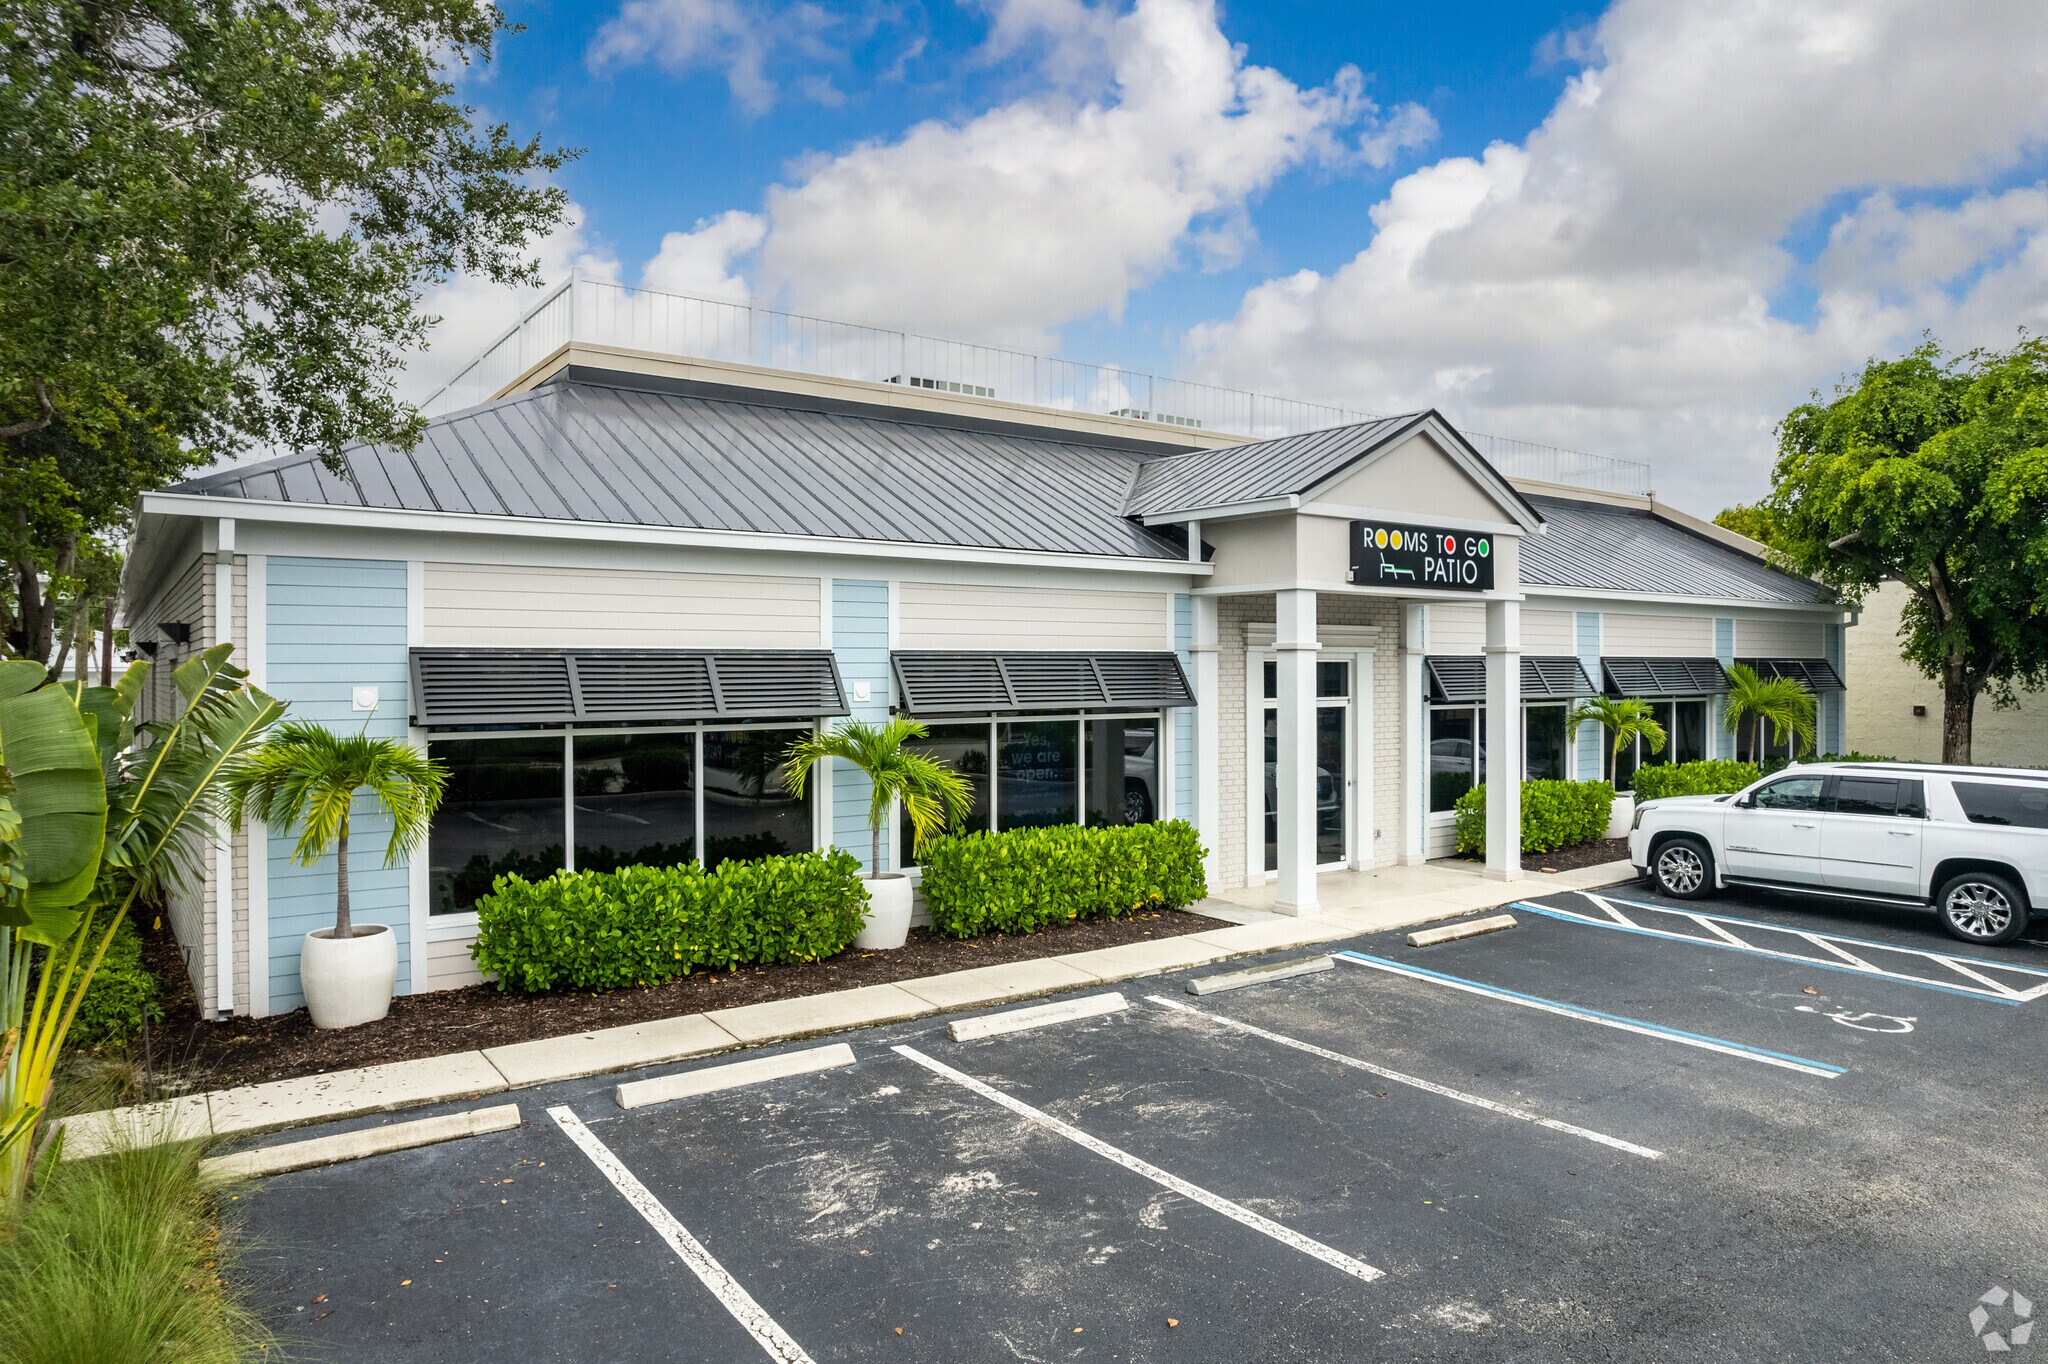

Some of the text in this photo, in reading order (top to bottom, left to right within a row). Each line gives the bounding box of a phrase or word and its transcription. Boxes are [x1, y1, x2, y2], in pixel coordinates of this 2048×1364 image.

[1363, 527, 1490, 558] ROOMS TO GO
[1424, 557, 1478, 584] PATIO
[1023, 732, 1050, 747] Yes,
[1011, 750, 1061, 764] we are
[1016, 768, 1058, 783] open.
